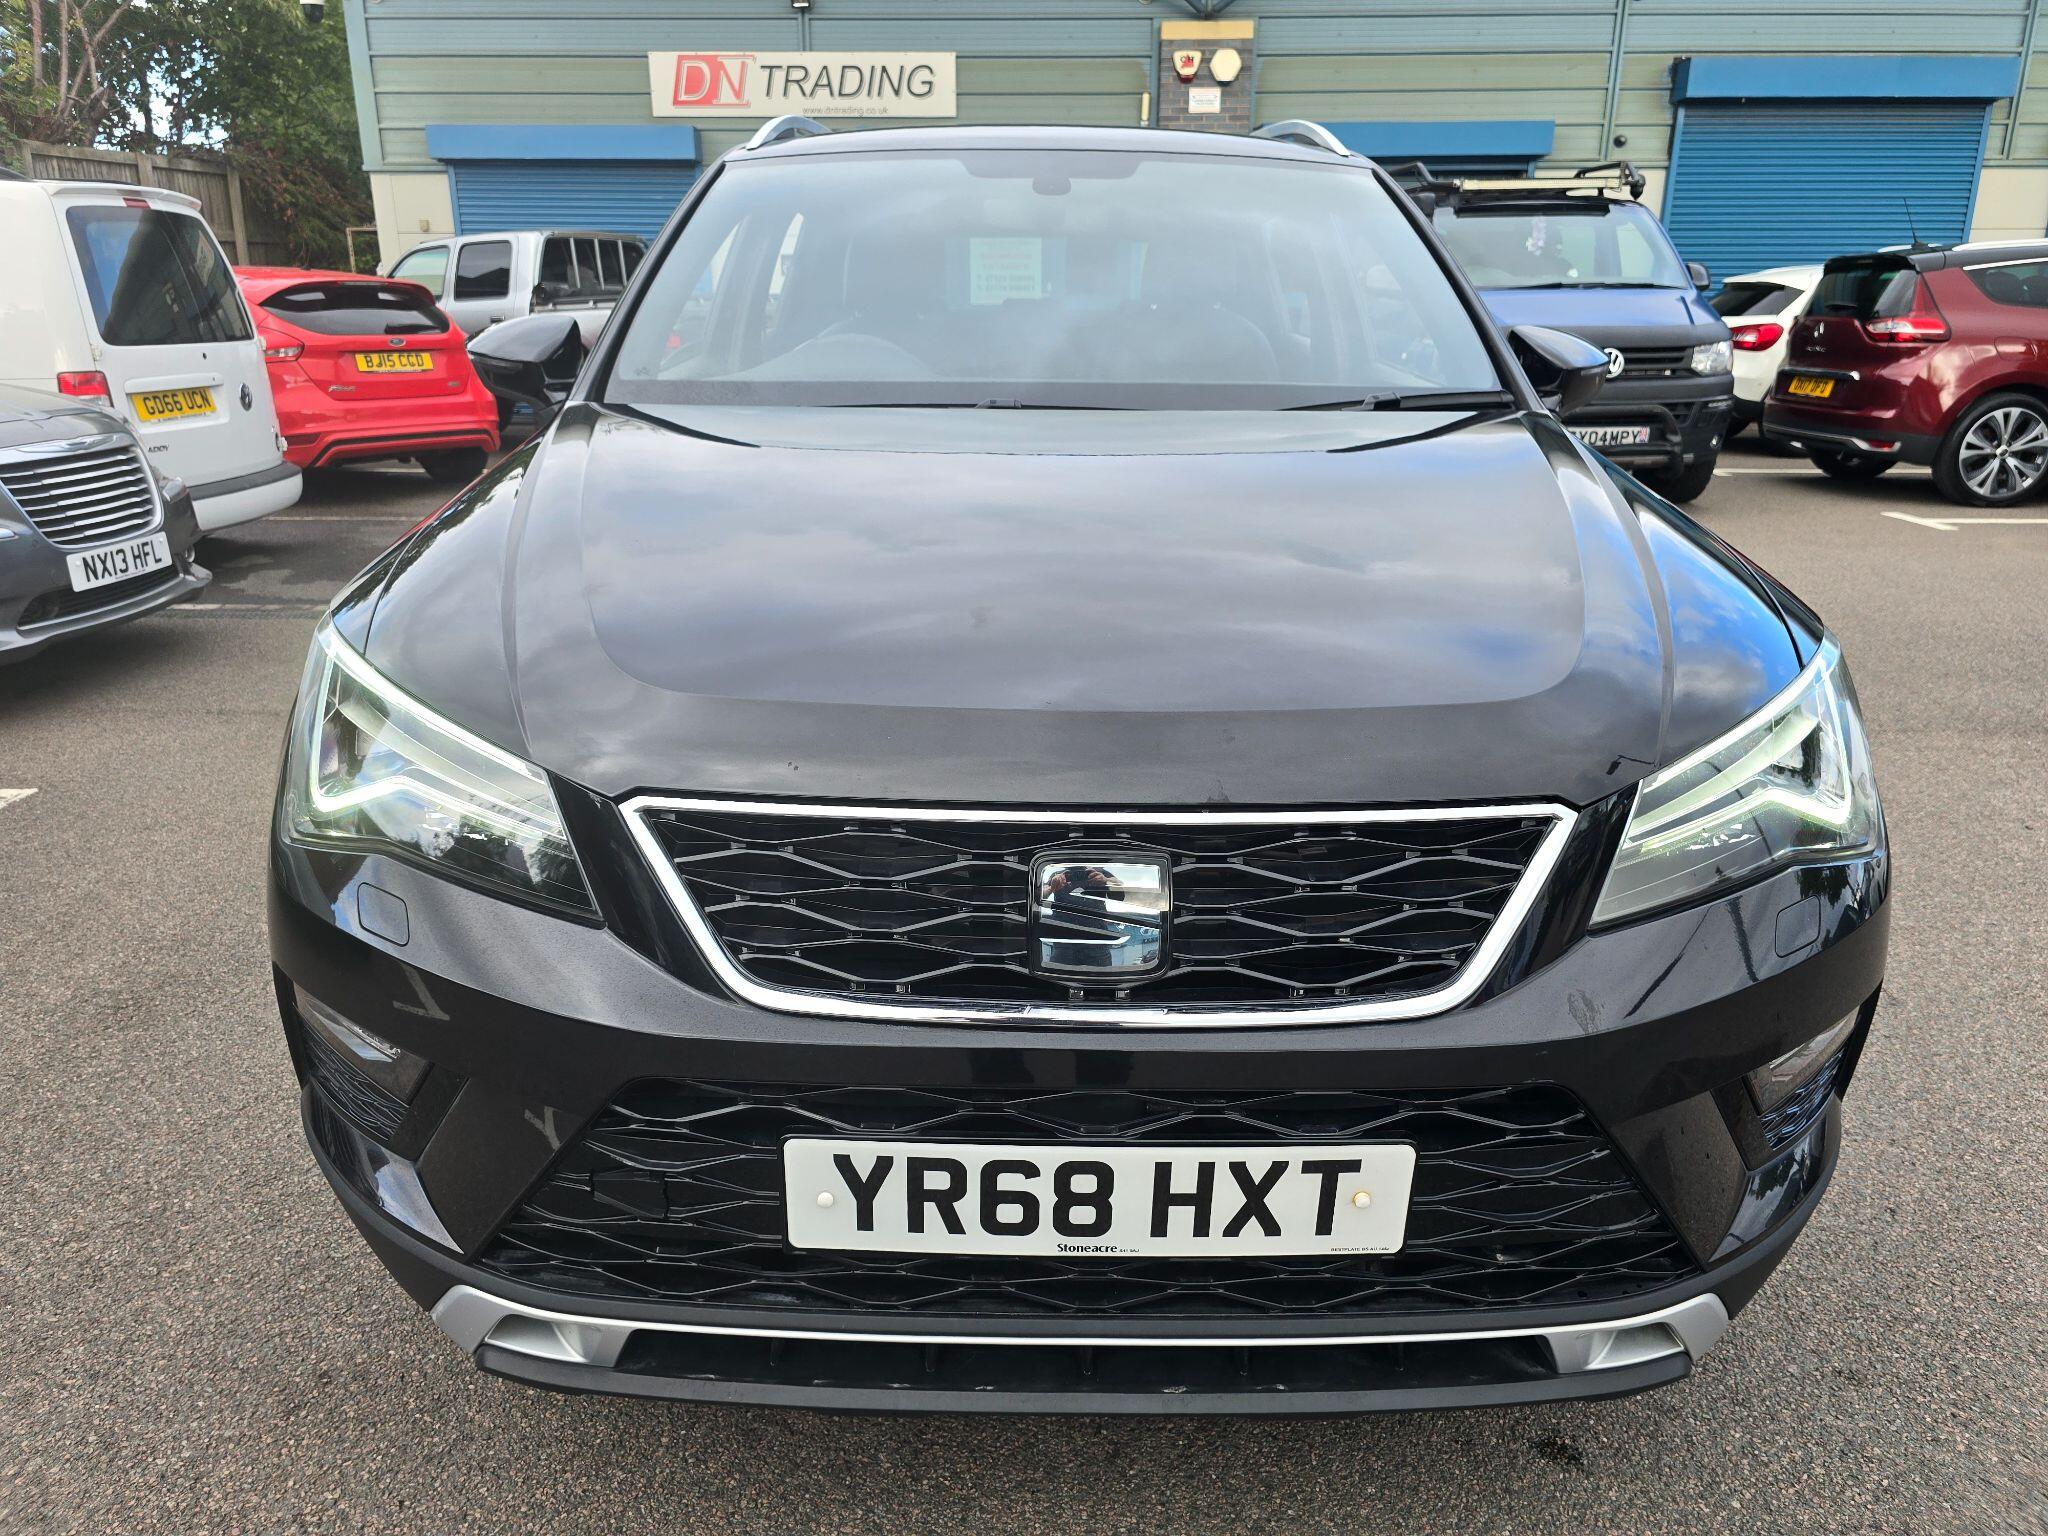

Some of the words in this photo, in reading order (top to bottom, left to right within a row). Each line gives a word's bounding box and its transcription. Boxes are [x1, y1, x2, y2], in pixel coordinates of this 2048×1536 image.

[674, 55, 755, 105] DN
[760, 64, 936, 99] TRADING
[363, 354, 396, 369] BJ15
[143, 393, 183, 416] GD66
[182, 388, 212, 410] UCN
[82, 548, 129, 582] NX13
[131, 540, 162, 570] HFL
[833, 1153, 1114, 1238] YR68
[1150, 1158, 1362, 1238] HXT
[1056, 1243, 1118, 1253] Stoneacre
